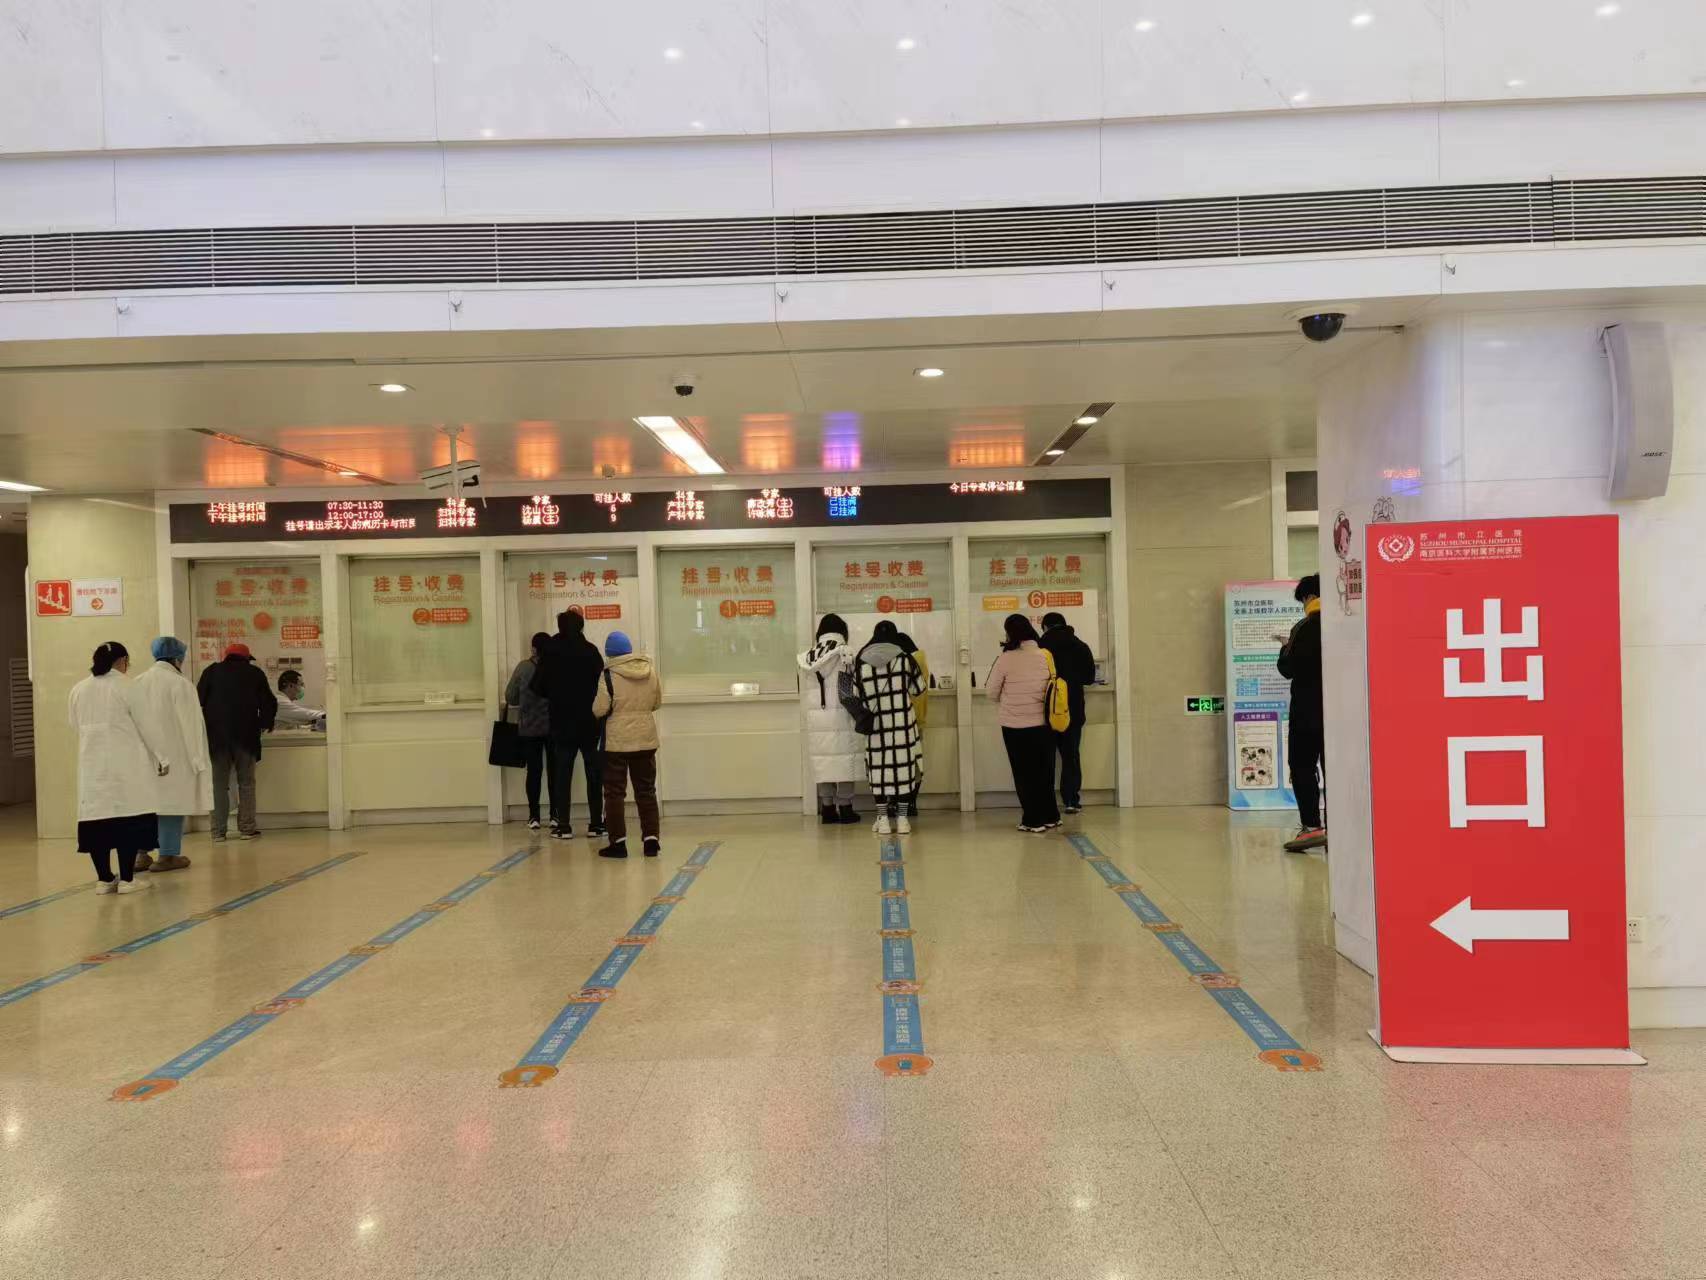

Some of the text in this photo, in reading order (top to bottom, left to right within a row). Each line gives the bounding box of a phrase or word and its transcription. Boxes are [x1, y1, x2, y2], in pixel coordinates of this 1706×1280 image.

[824, 486, 861, 496] 可挂人数
[594, 493, 632, 503] 可挂人数
[829, 497, 857, 506] 已挂满
[207, 502, 266, 512] 上午挂号时间
[327, 502, 383, 510] 07:30-11:30
[667, 500, 704, 510] 产科专家
[327, 511, 384, 520] 12:00-17:00
[438, 508, 476, 517] 妇科专家
[667, 510, 705, 520] 产科专家
[829, 506, 857, 516] 已挂满
[207, 512, 266, 522] 下午挂号时间
[438, 517, 477, 527] 妇科专家
[611, 514, 617, 522] 9
[1420, 529, 1522, 540] 苏州市立医院
[1489, 537, 1522, 545] HOSPITAL
[1420, 547, 1522, 557] 南京医科大学附属苏州医院
[844, 560, 924, 577] 挂号·收费
[990, 555, 1081, 576] 挂号·收费
[374, 575, 464, 592] 挂号·收费
[529, 570, 619, 588] 挂号·收费
[1443, 598, 1545, 828] 出口
